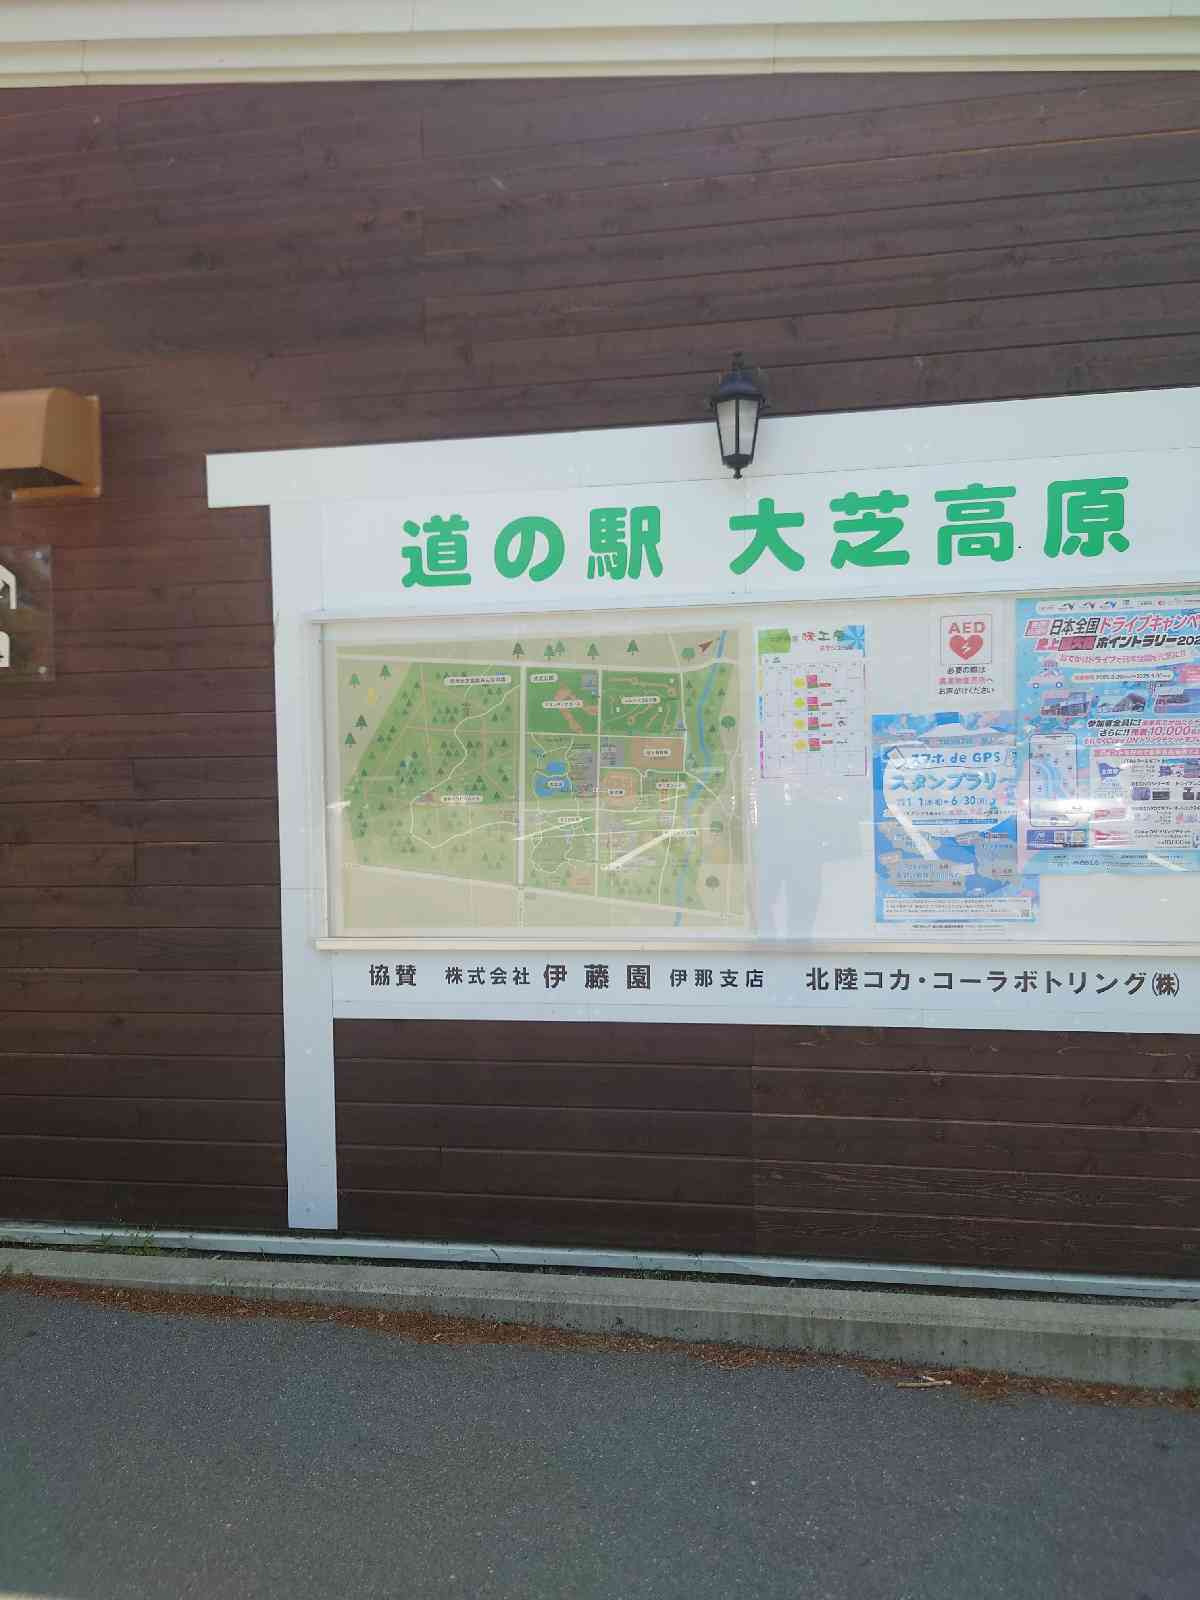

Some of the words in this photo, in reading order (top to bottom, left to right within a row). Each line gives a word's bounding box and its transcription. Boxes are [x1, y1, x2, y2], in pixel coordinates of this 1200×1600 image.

[401, 506, 663, 588] 道の駅
[729, 476, 1131, 576] 大芝高原
[949, 621, 985, 634] AED
[949, 752, 967, 763] de
[972, 751, 1001, 762] GPS
[889, 768, 1018, 791] スタンプラリー
[369, 963, 417, 987] 協賛
[445, 966, 531, 986] 株式会社
[543, 963, 651, 990] 伊藤園
[670, 968, 763, 988] 伊那支店
